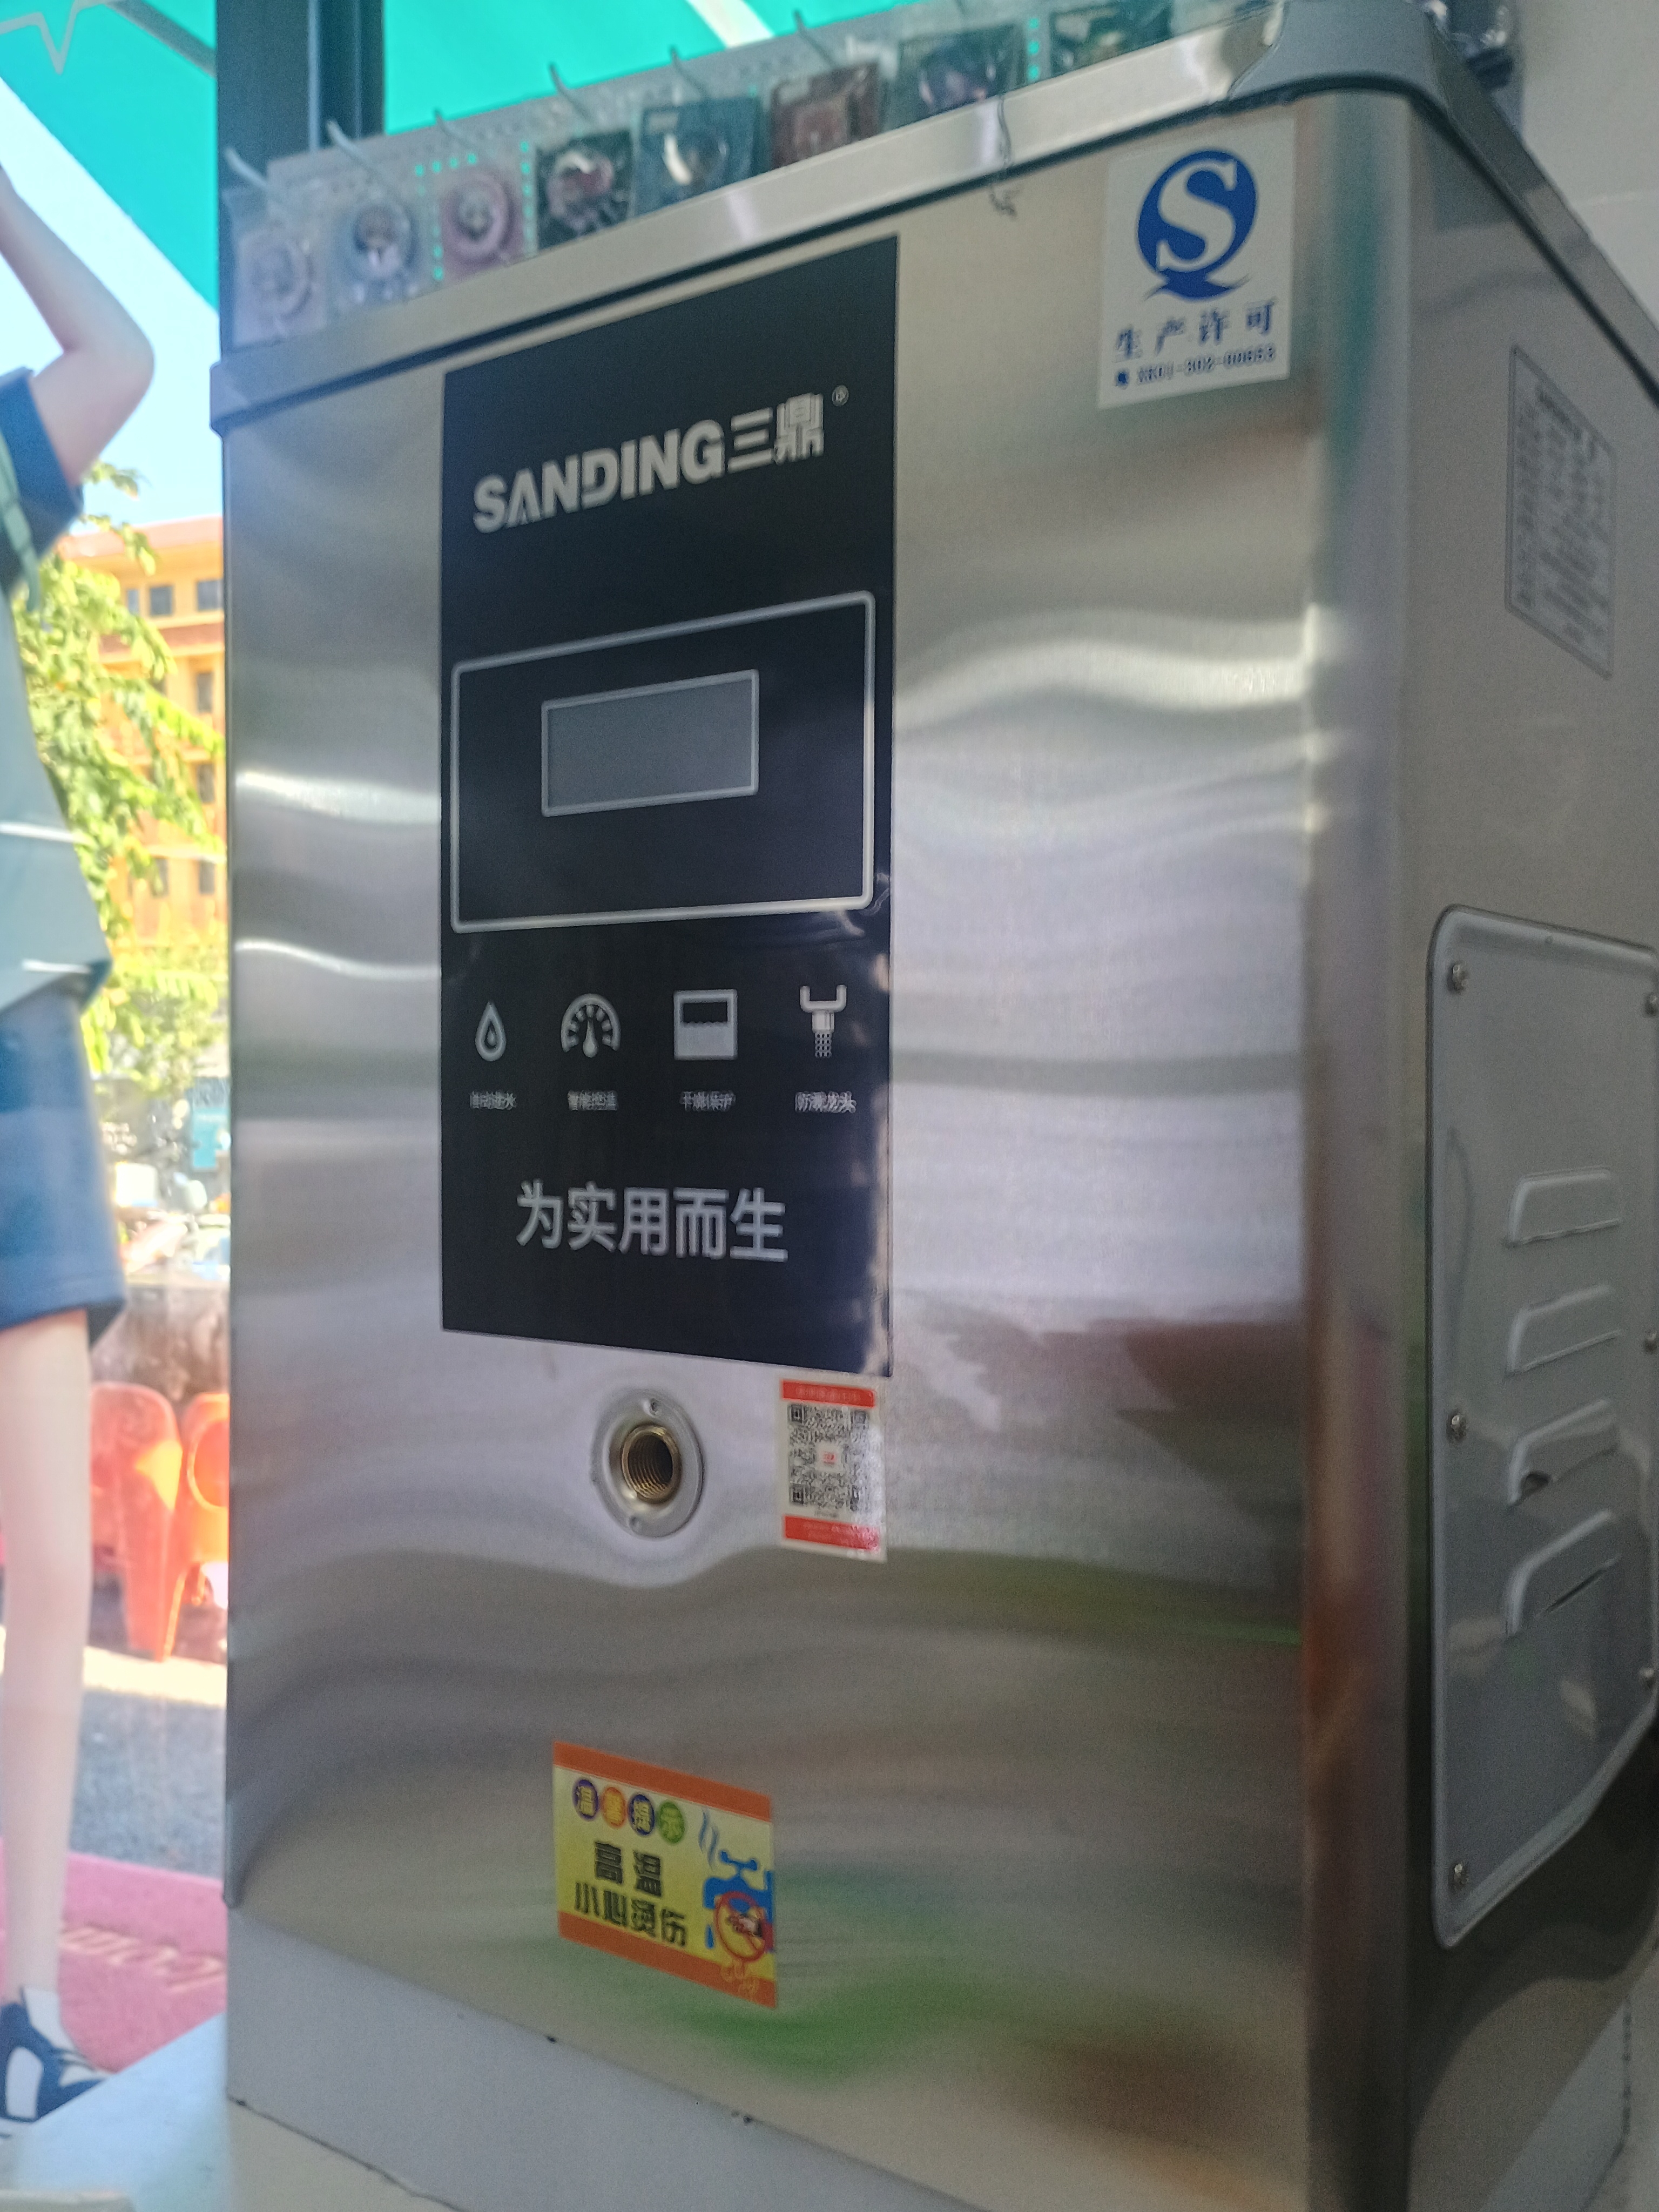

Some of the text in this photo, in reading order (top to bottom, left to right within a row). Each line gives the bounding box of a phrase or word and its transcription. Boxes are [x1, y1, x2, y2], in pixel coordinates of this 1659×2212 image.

[1114, 299, 1277, 362] 生产许可
[474, 392, 824, 533] SANDING 三鼎
[516, 1178, 788, 1263] 为实用而生
[595, 1841, 662, 1897] 高温
[575, 1881, 685, 1947] 小心烫伤
